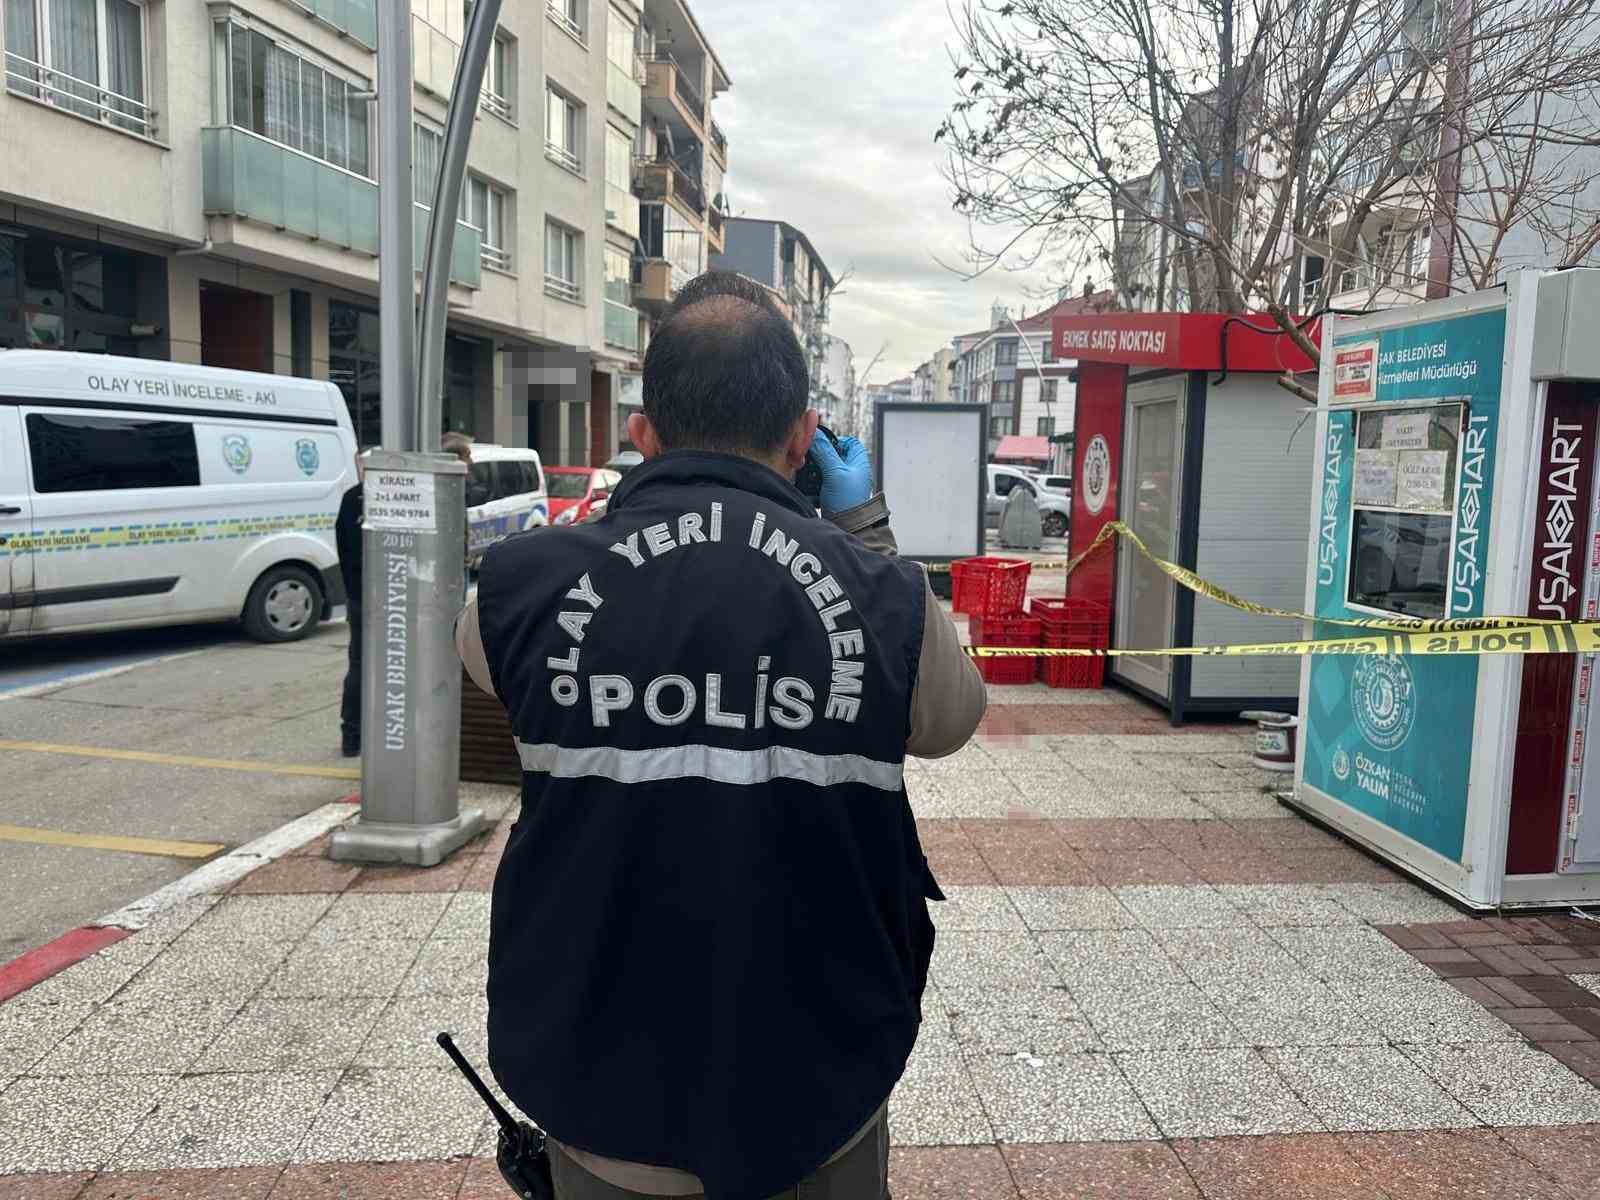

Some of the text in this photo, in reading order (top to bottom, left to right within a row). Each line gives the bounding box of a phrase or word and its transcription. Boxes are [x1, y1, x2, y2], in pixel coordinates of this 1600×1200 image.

[1062, 331, 1166, 353] EKMEK SATIŞ NOKTASI
[1397, 340, 1447, 363] BELEDİYESİ
[1421, 360, 1477, 380] Müdürlüğü
[87, 375, 129, 392] OLAY
[134, 378, 170, 397] YERİ
[173, 379, 244, 402] İNCELEME
[255, 389, 277, 405] AKİ
[379, 474, 416, 488] KİRALIK
[392, 493, 421, 504] APART
[383, 552, 408, 686] BELEDİYESİ
[545, 501, 866, 724] OLAY YERİ İNCELEME
[589, 655, 816, 731] POLİS
[1355, 752, 1390, 783] ÖZKAN
[1356, 770, 1389, 801] YALIM
